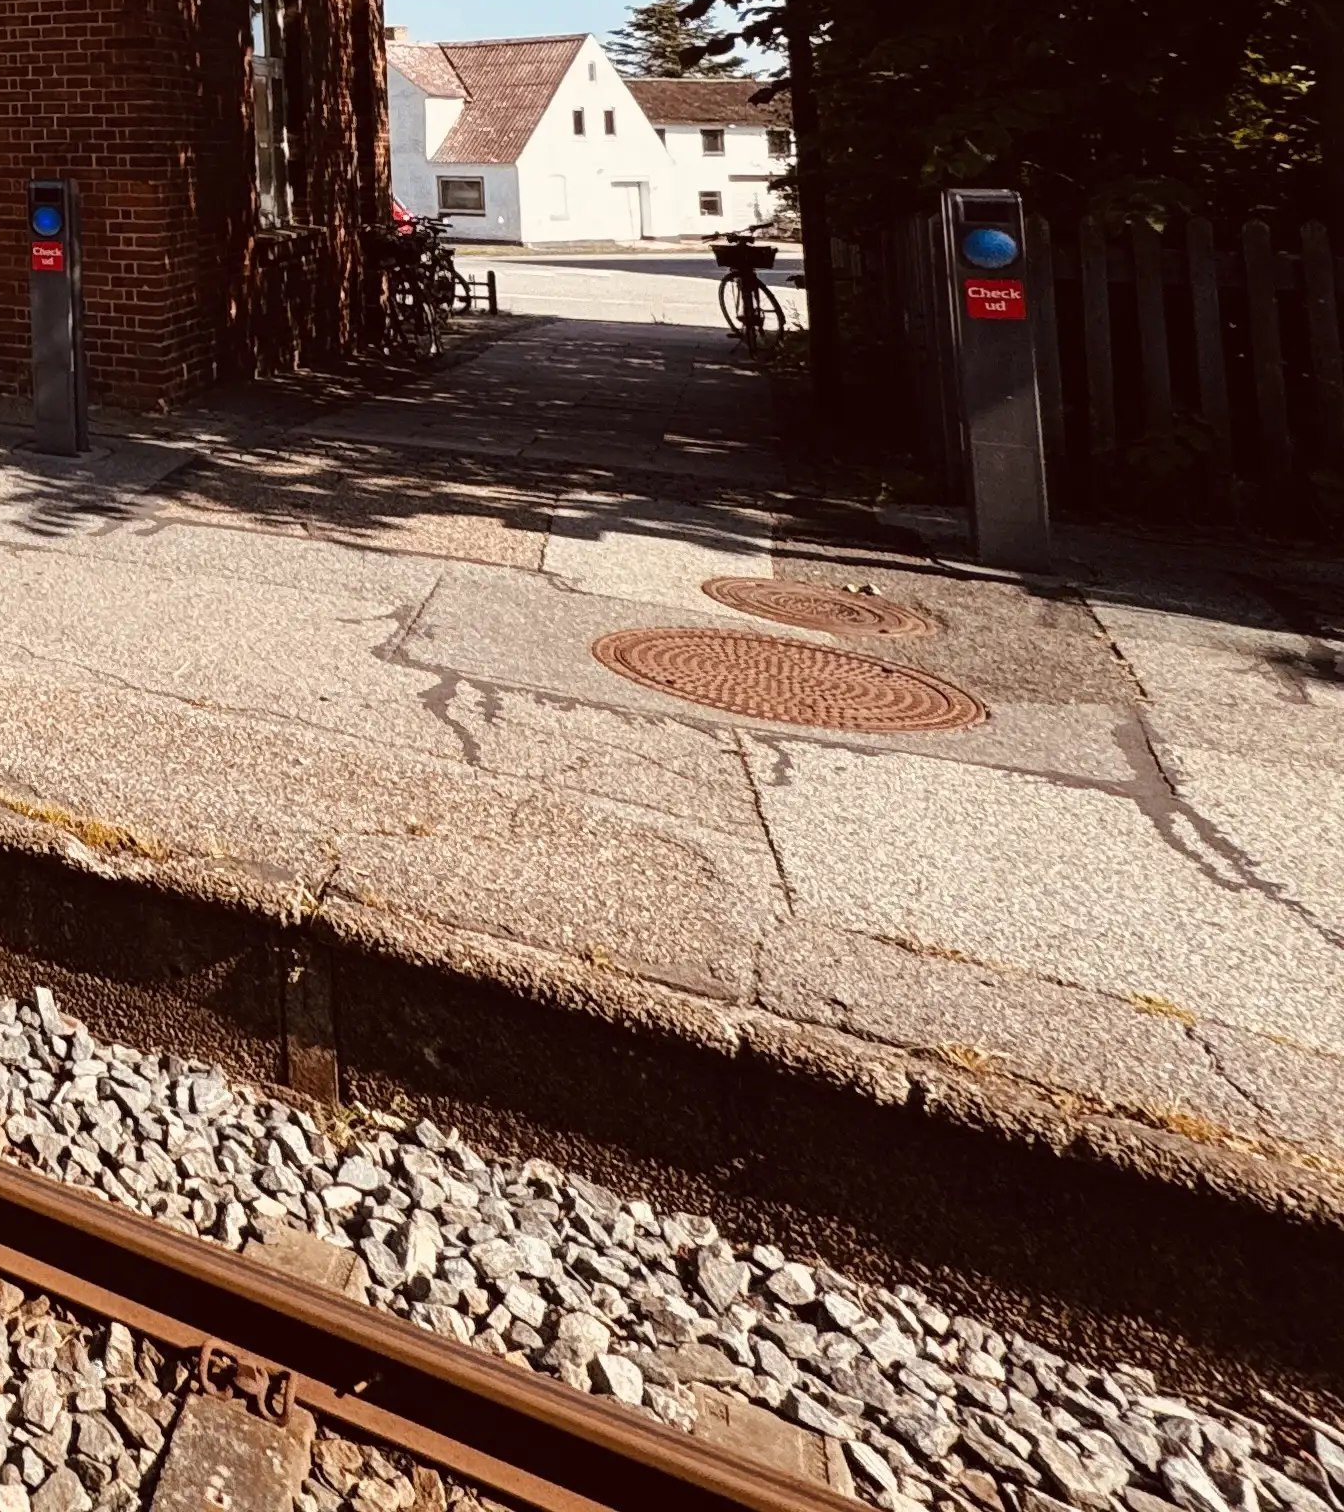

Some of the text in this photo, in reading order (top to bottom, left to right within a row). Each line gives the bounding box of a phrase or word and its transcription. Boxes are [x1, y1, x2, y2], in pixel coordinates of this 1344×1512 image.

[32, 247, 63, 256] Check
[968, 287, 1022, 299] Check
[984, 300, 1007, 312] ud
